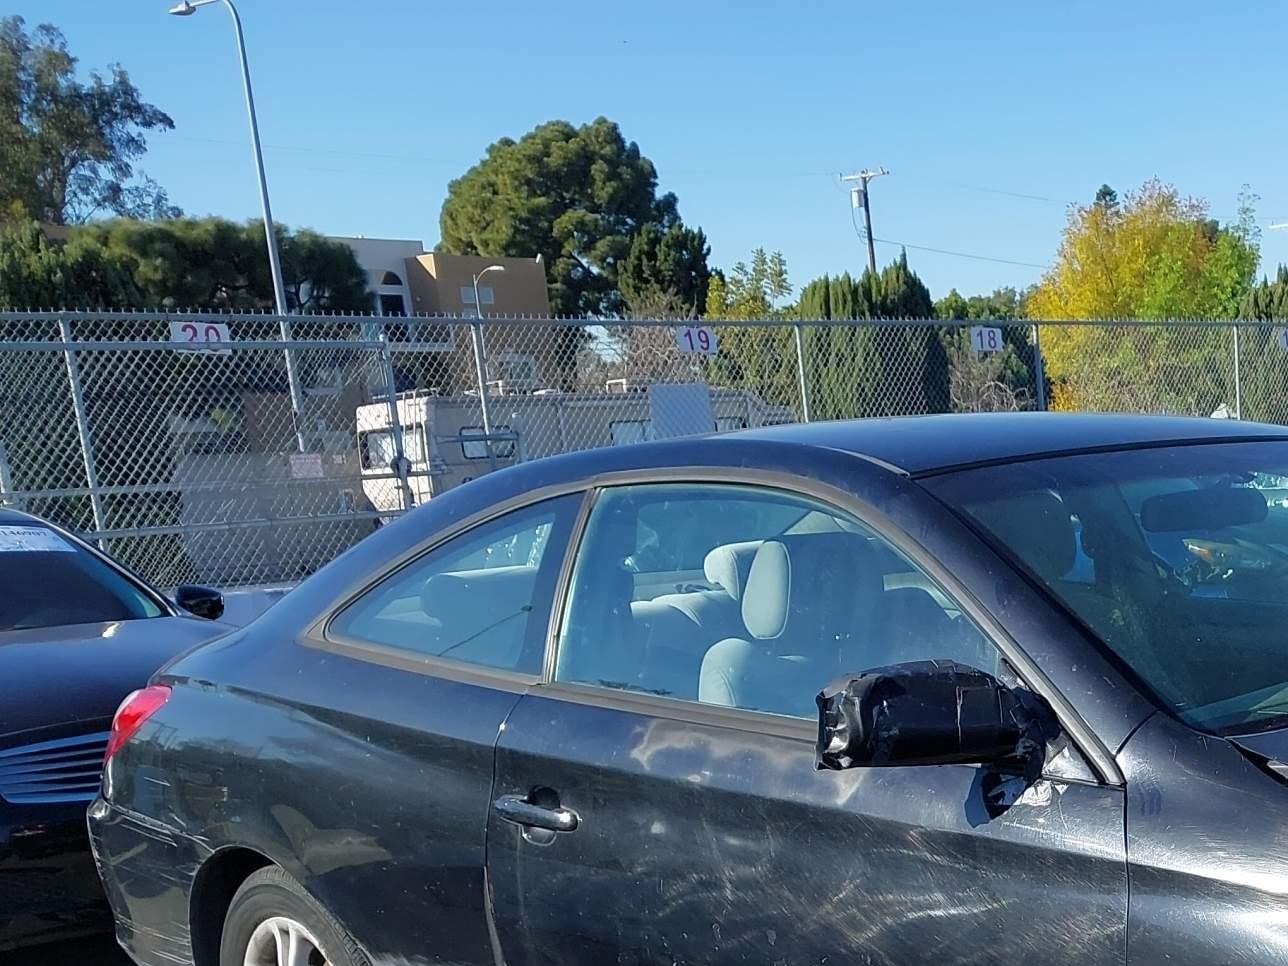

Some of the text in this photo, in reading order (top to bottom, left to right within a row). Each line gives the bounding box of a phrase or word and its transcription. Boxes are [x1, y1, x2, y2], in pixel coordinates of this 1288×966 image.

[181, 324, 221, 352] 20
[684, 329, 709, 350] 19
[977, 330, 996, 349] 18
